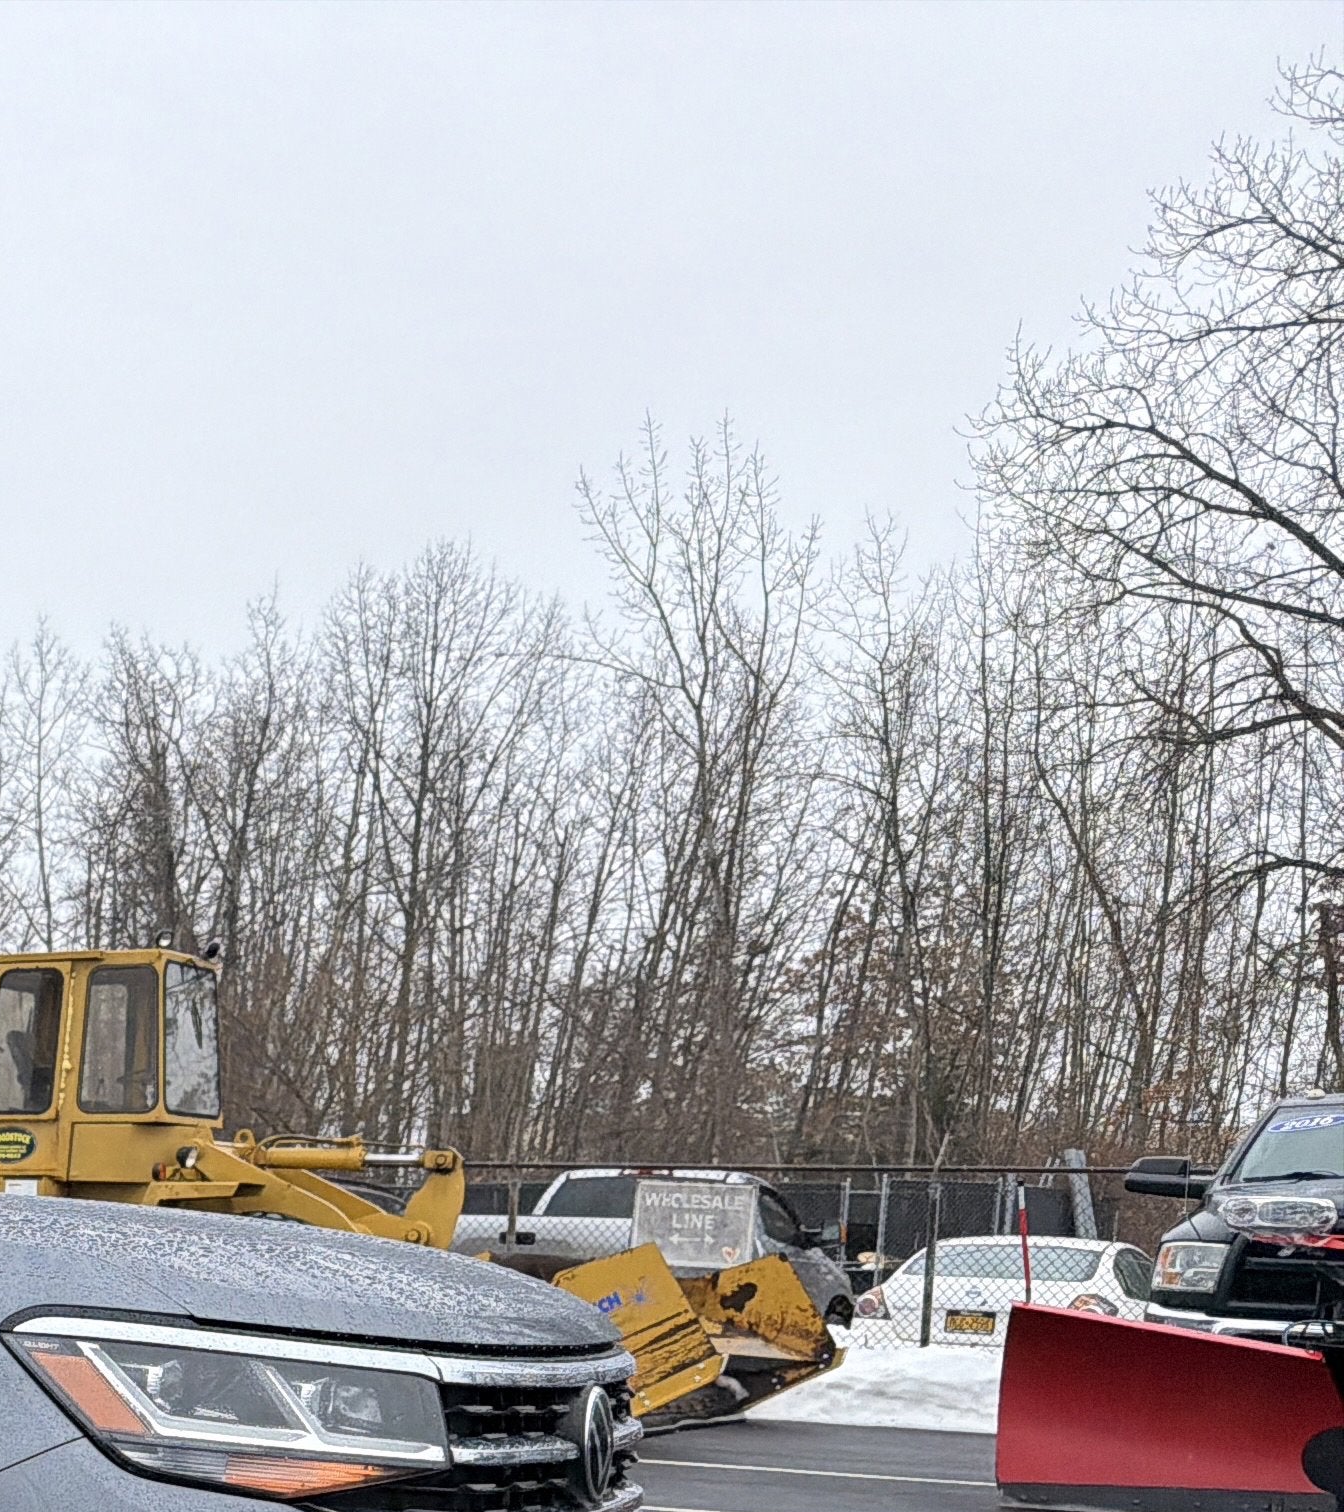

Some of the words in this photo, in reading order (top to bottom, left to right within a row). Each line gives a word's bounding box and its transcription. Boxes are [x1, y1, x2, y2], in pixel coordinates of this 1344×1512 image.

[644, 1192, 745, 1210] WHOLESALE
[672, 1213, 715, 1230] LINE
[597, 1291, 622, 1313] CH
